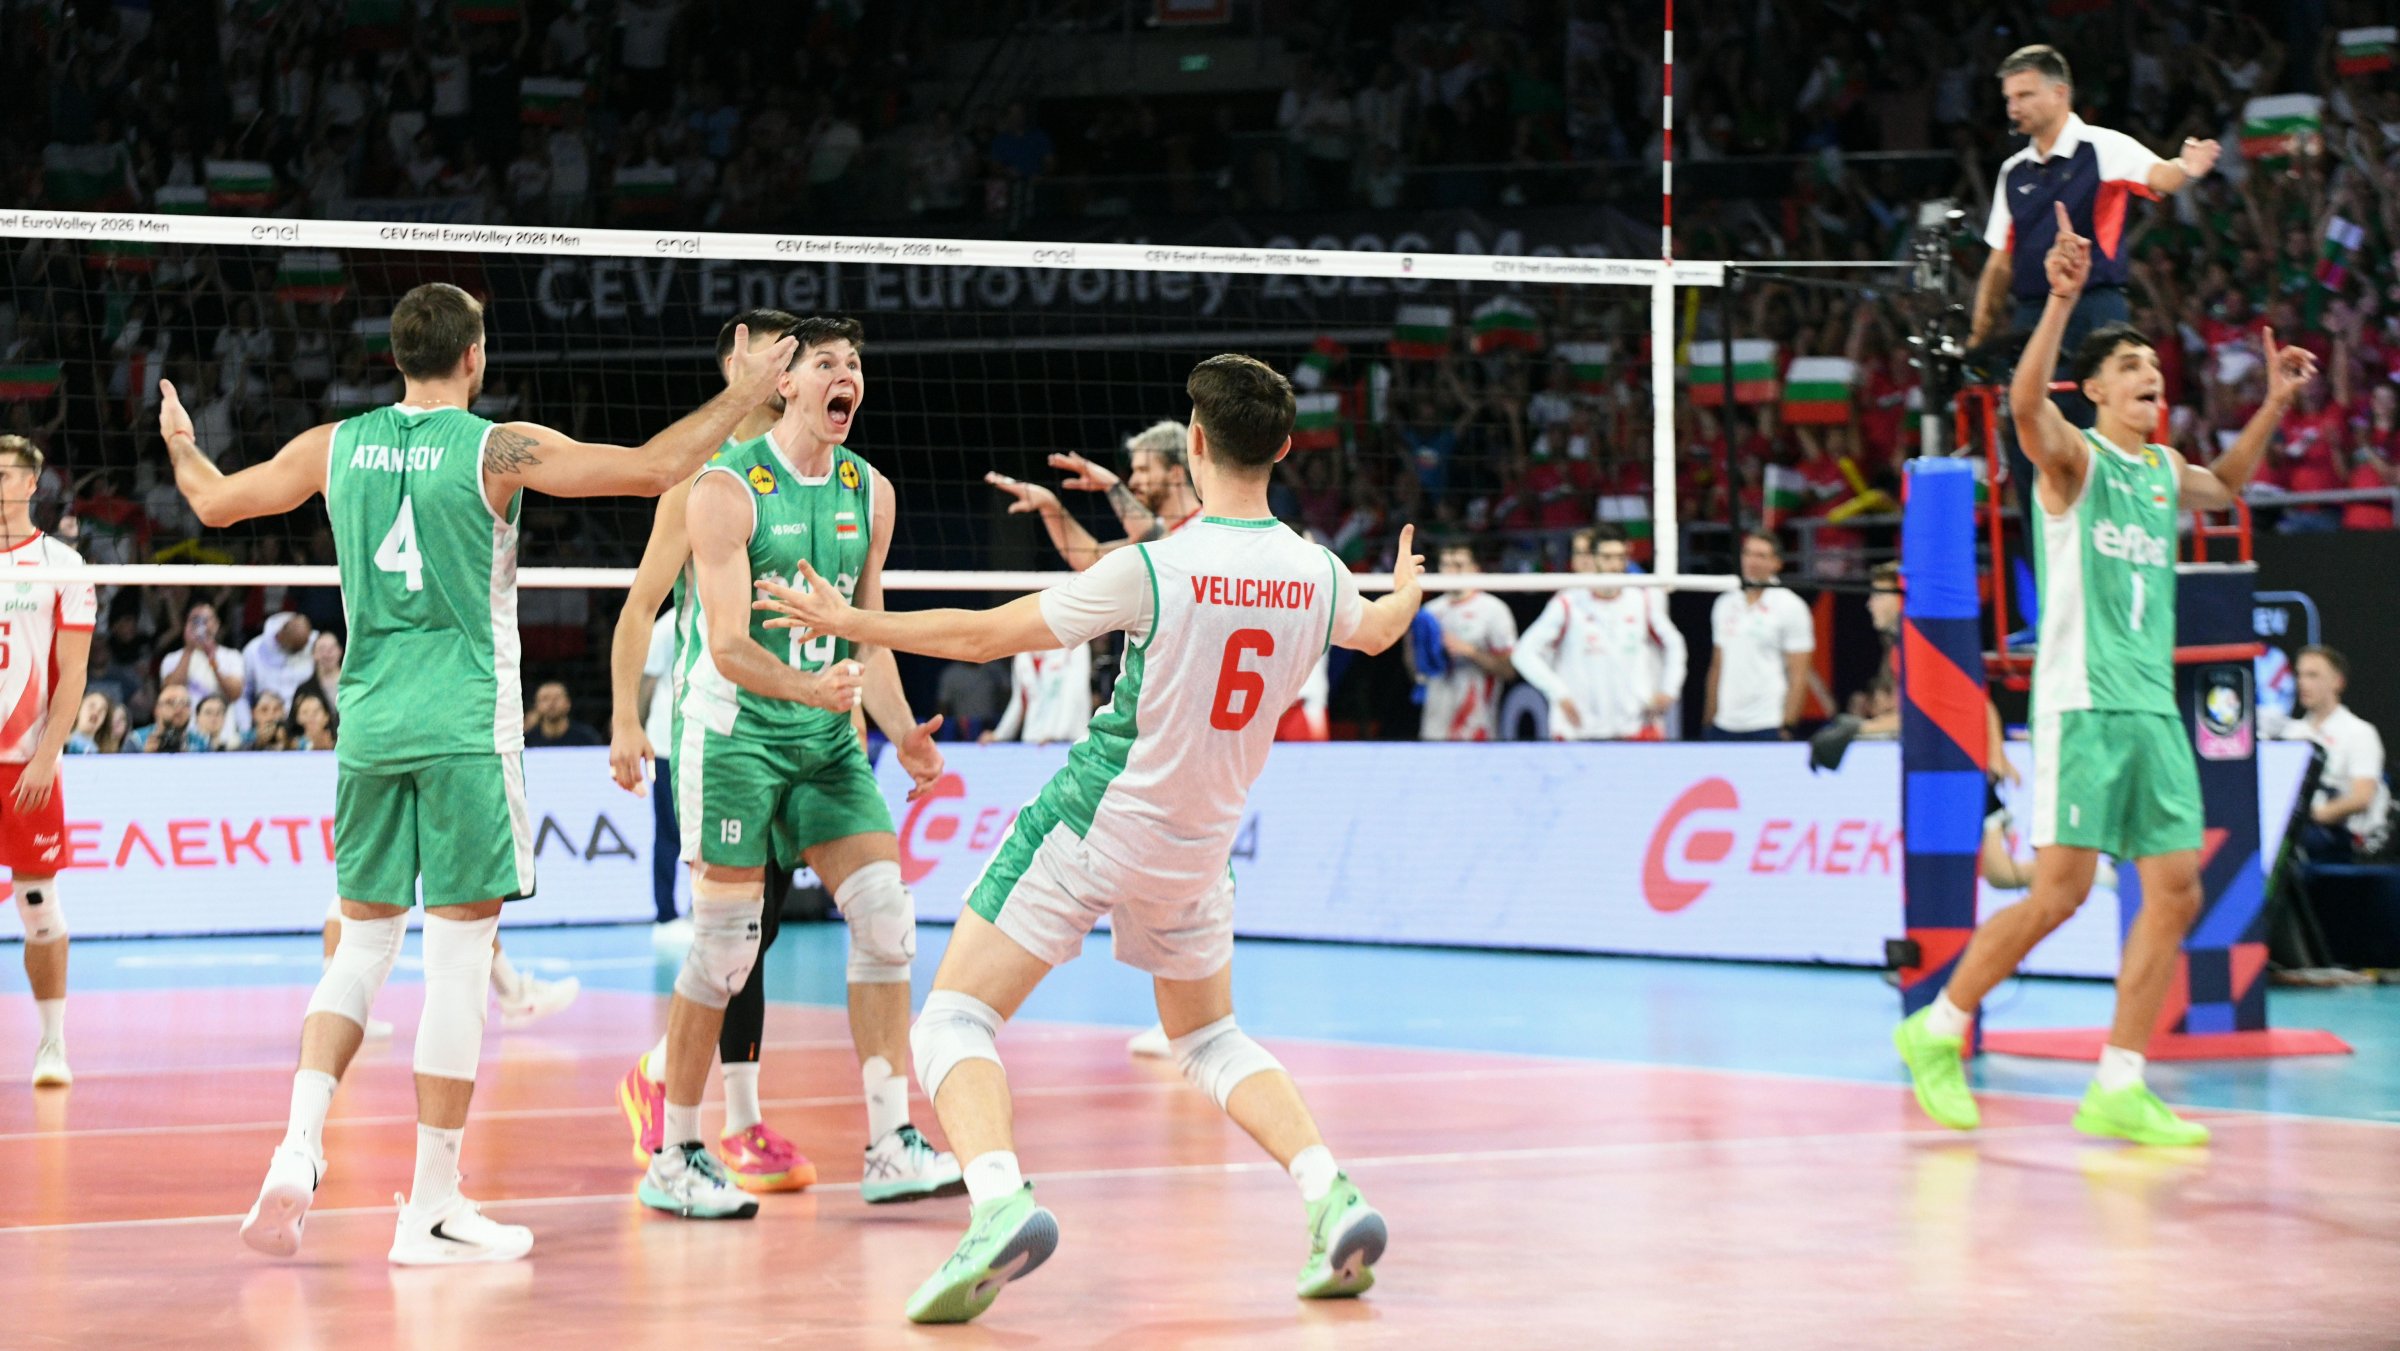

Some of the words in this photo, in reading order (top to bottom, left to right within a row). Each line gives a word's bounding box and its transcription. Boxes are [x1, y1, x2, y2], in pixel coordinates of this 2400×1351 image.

[0, 215, 18, 228] nel
[22, 215, 97, 233] EuroVolley
[101, 218, 134, 232] 2026
[139, 219, 169, 233] Men
[251, 224, 299, 240] enel
[380, 227, 407, 240] CEV
[412, 227, 440, 241] Enel
[443, 229, 512, 247] EuroVolley
[516, 231, 547, 245] 2026
[551, 233, 580, 246] Men
[656, 237, 700, 253] enel
[775, 239, 802, 253] CEV
[806, 240, 831, 253] Enel
[1033, 248, 1076, 264] enel
[536, 257, 678, 320] CEV
[699, 257, 841, 315] Enel
[350, 444, 445, 473] ATANSOV
[373, 494, 424, 592] 4
[1191, 575, 1315, 610] VELICHKOV
[2129, 572, 2145, 631] 1
[788, 622, 836, 675] 19
[1209, 628, 1275, 731] 6
[720, 818, 742, 844] 19
